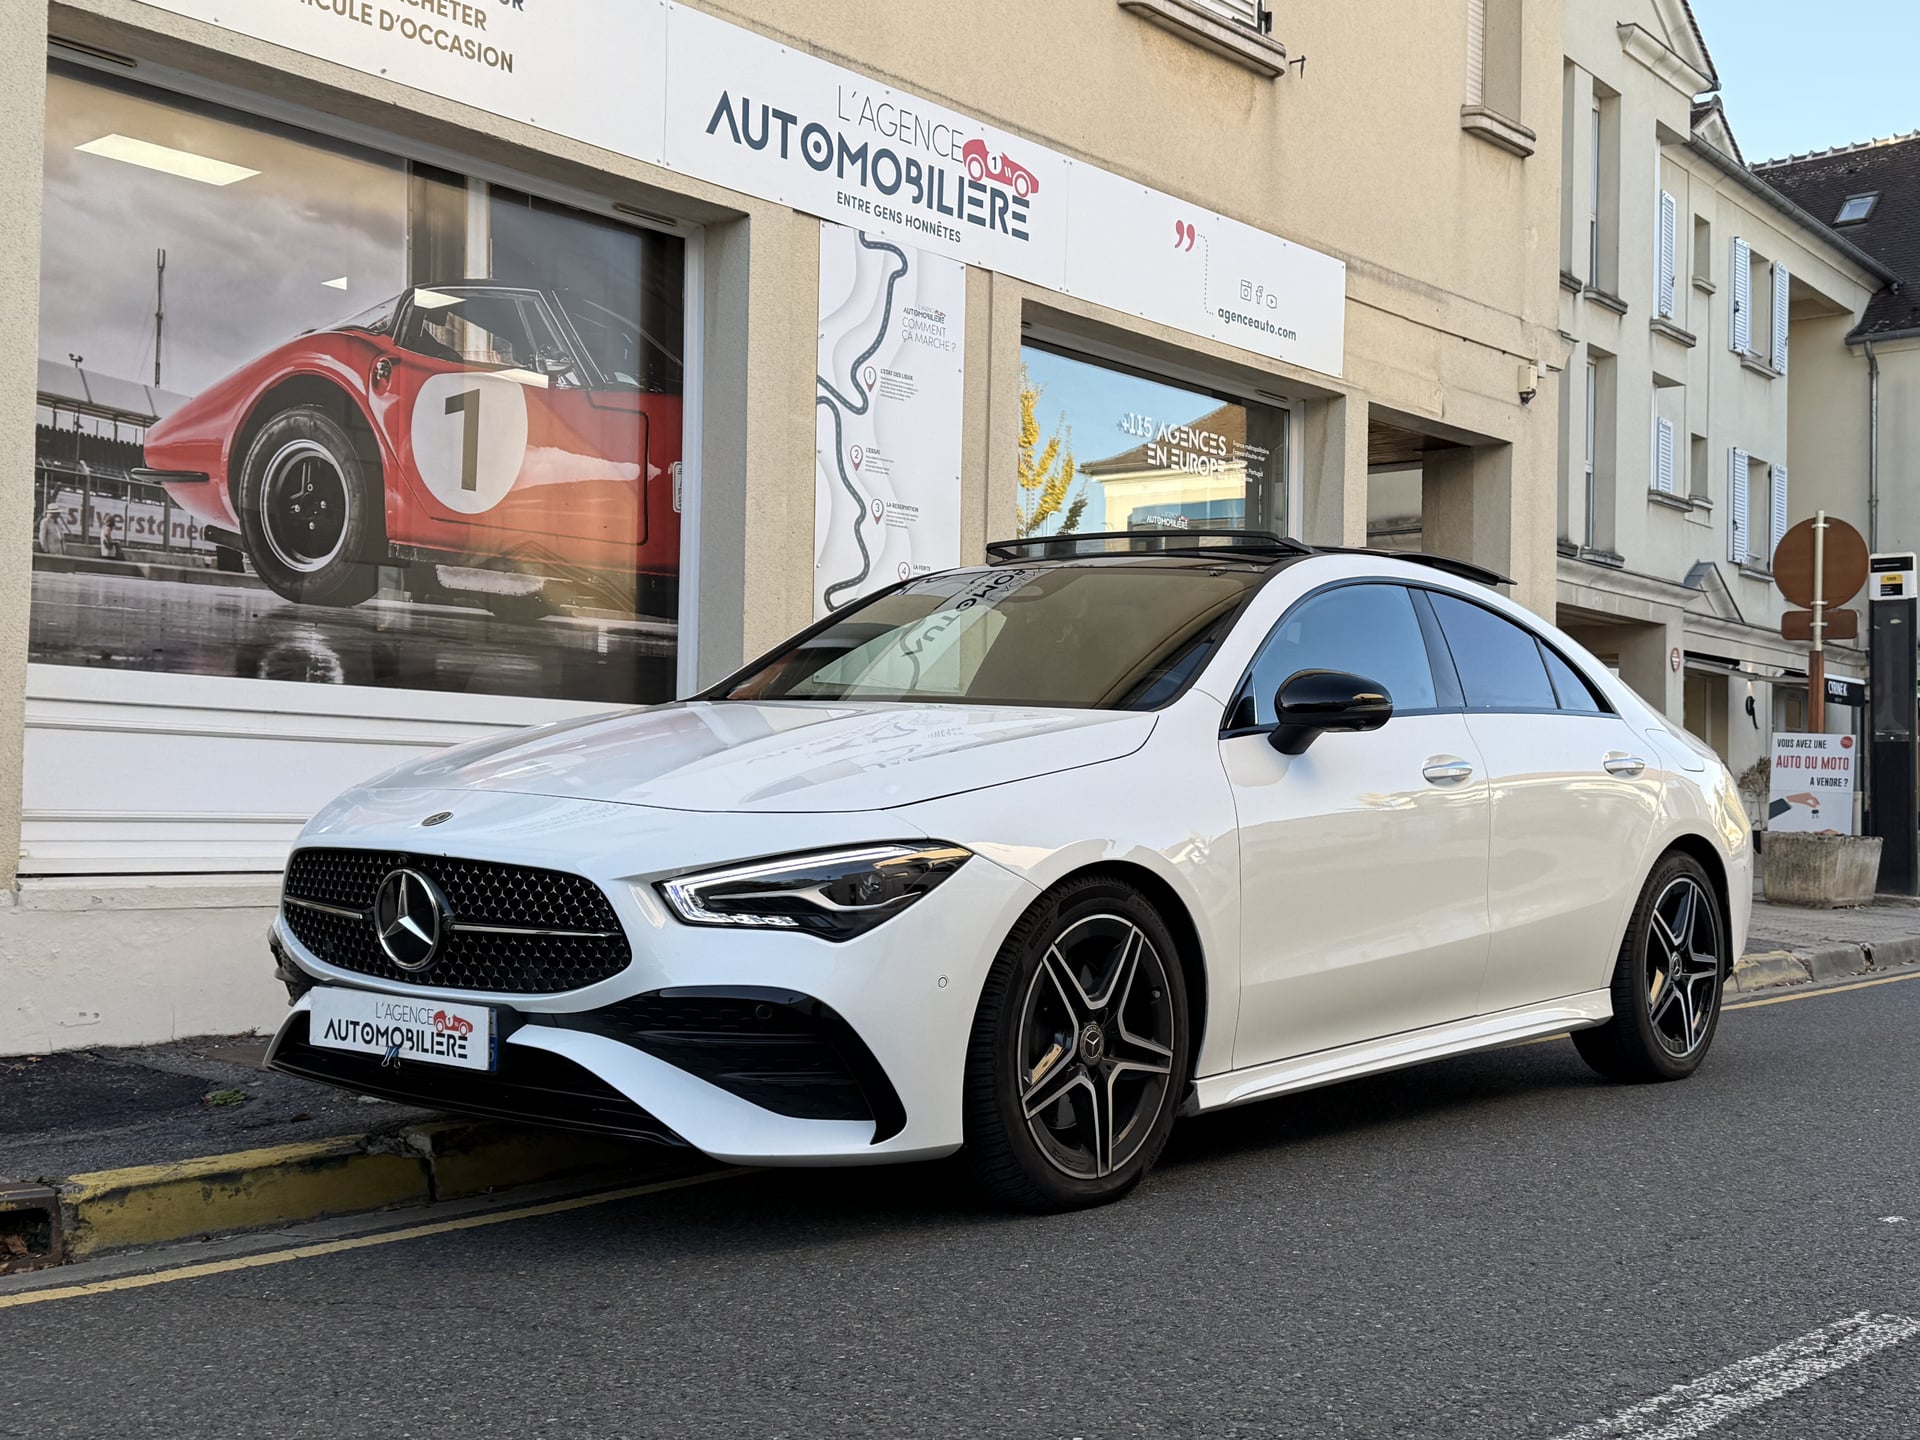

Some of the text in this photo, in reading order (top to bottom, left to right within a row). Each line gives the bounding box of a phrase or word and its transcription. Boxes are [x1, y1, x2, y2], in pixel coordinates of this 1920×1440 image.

[401, 0, 486, 31] HETER
[379, 10, 513, 73] D'OCCASION
[838, 84, 964, 163] L'AGENCE
[837, 191, 961, 243] ENTRE GENS HONNÊTES
[902, 316, 946, 337] COMMENT
[1218, 306, 1297, 341] agenceauto.com
[902, 329, 914, 343] ÇA
[914, 332, 950, 352] MARCHE
[444, 388, 480, 492] 1
[1121, 412, 1227, 456] +115 AGENCES
[854, 449, 860, 459] 2
[1147, 443, 1226, 476] EN EUROPE
[67, 504, 199, 540] slverstone
[875, 502, 881, 513] 3
[1777, 739, 1827, 749] VOUS AVEZ UNE
[1776, 755, 1850, 771] AUTO OU MOTO
[1810, 777, 1849, 788] A VENDRE ?
[375, 1001, 435, 1026] L'AGENCE
